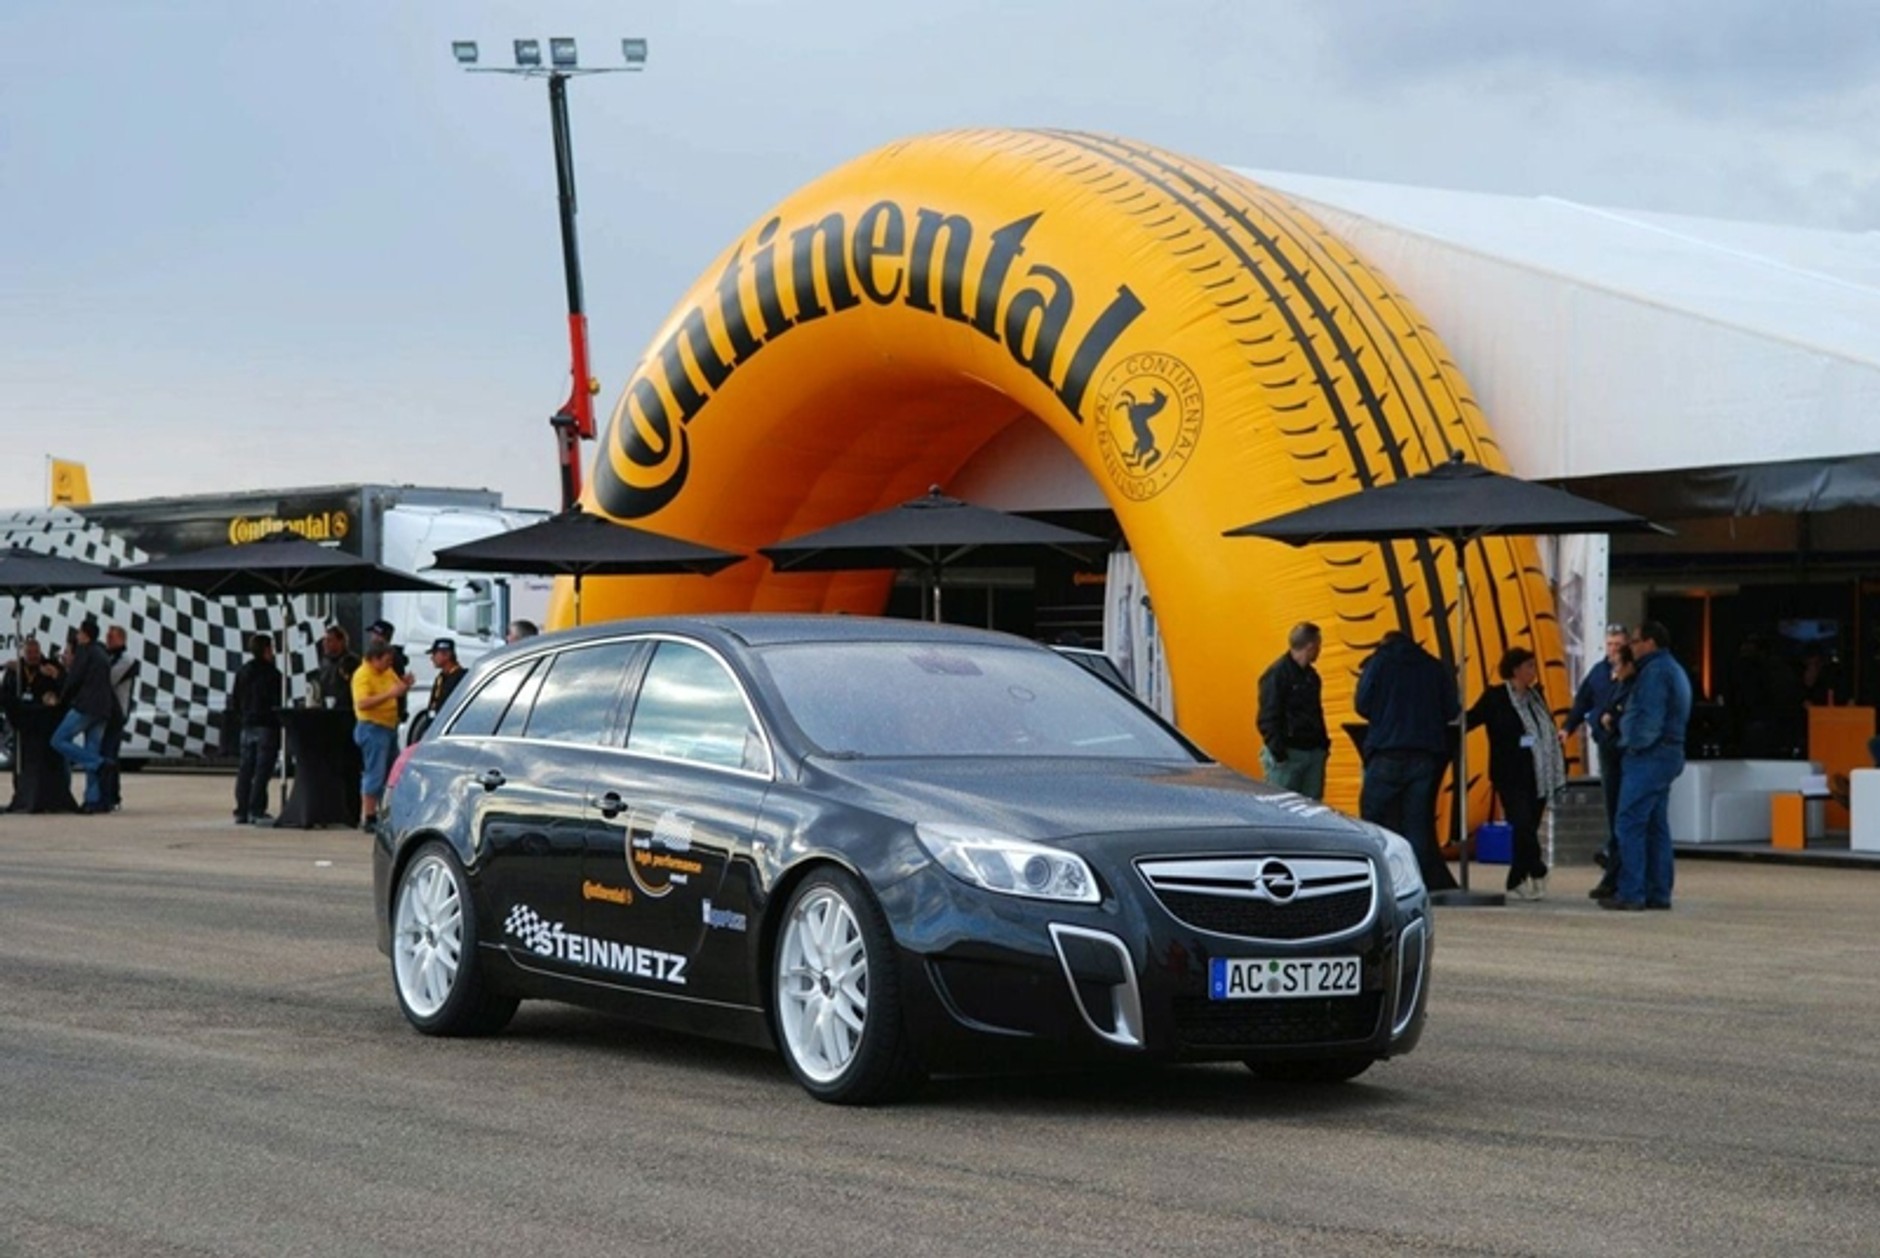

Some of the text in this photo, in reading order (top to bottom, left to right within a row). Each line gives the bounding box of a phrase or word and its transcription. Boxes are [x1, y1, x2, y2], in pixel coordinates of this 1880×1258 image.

[593, 200, 1147, 519] Continental
[1126, 355, 1200, 461] CONTINENTAL
[534, 926, 687, 985] STEINMETZ
[1228, 961, 1357, 993] AC ST 222
